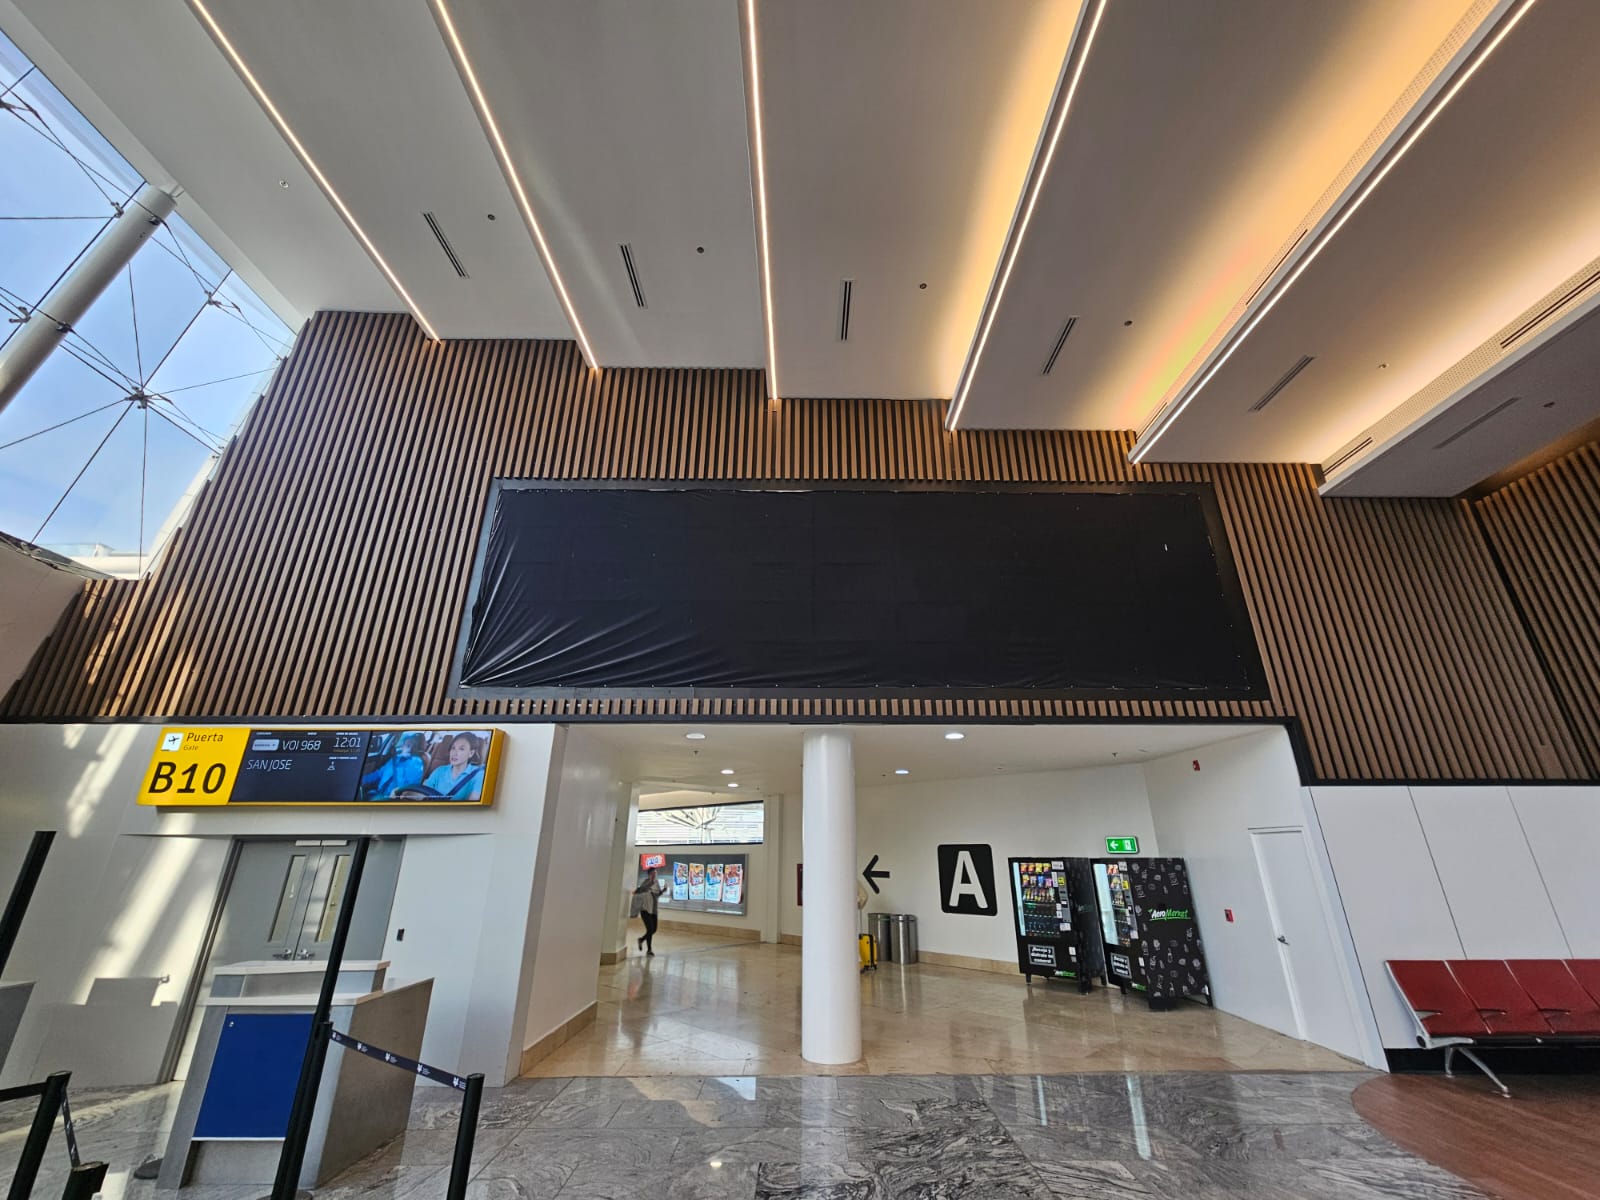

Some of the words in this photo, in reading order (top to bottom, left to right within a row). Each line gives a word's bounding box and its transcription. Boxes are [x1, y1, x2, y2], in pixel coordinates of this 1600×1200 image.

[186, 732, 224, 742] Puerta
[333, 737, 360, 748] 12:01
[282, 740, 299, 750] VOI
[301, 740, 321, 751] 968
[246, 760, 268, 770] SAN
[267, 760, 292, 772] JOSE
[148, 762, 226, 794] B10
[949, 850, 988, 909] A
